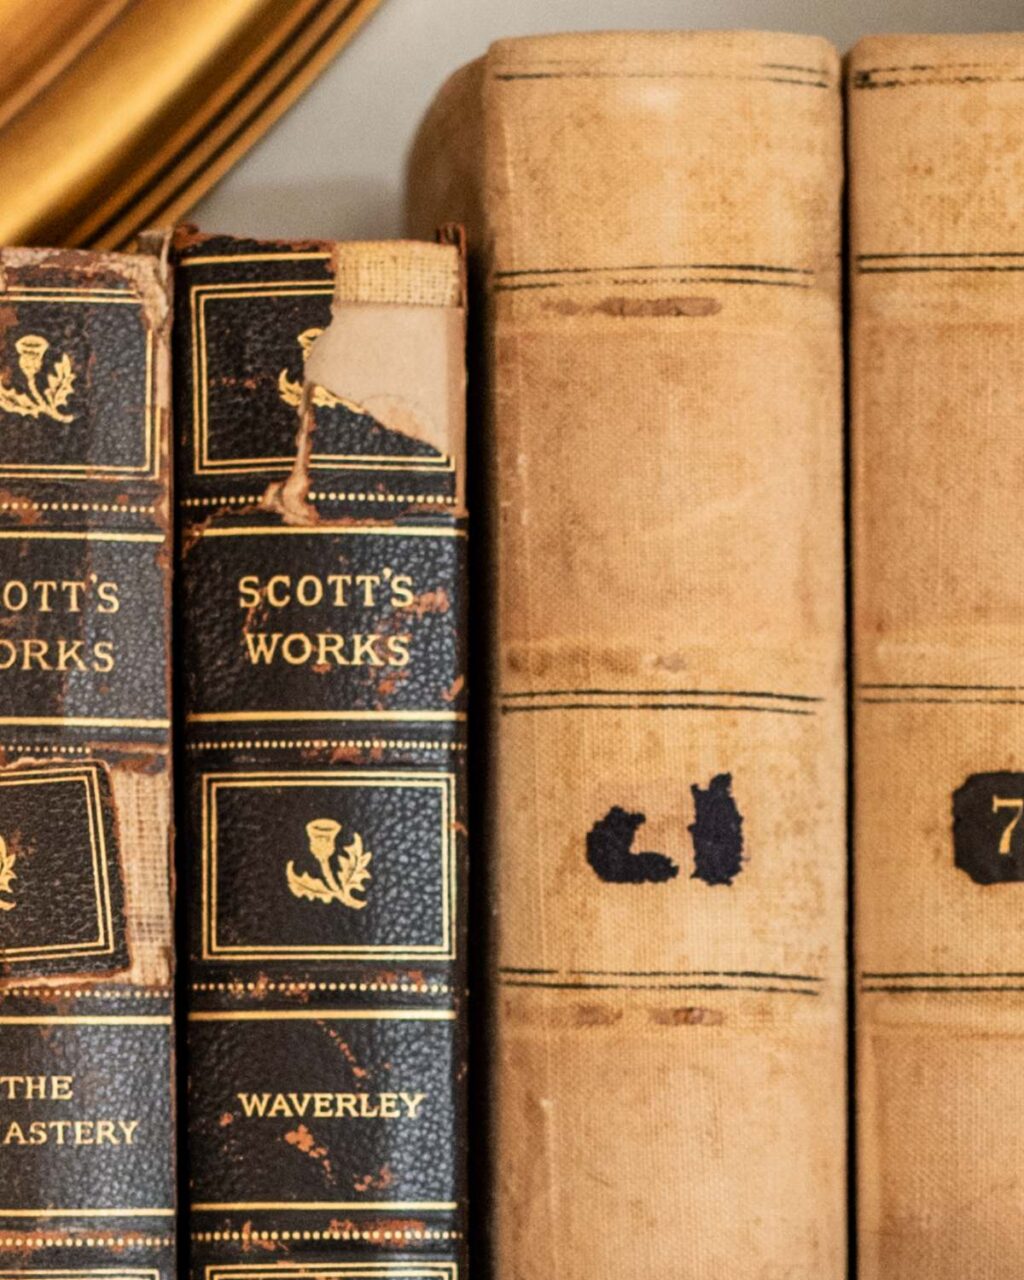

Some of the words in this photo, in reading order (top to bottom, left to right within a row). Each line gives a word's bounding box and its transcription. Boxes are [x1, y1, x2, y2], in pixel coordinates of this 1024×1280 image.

[2, 573, 120, 614] OTT'S
[238, 568, 415, 608] SCOTT'S
[245, 632, 411, 666] WORKS
[0, 1075, 74, 1100] THE
[238, 1092, 426, 1118] WAVERLEY
[3, 1120, 139, 1145] ASTERY
